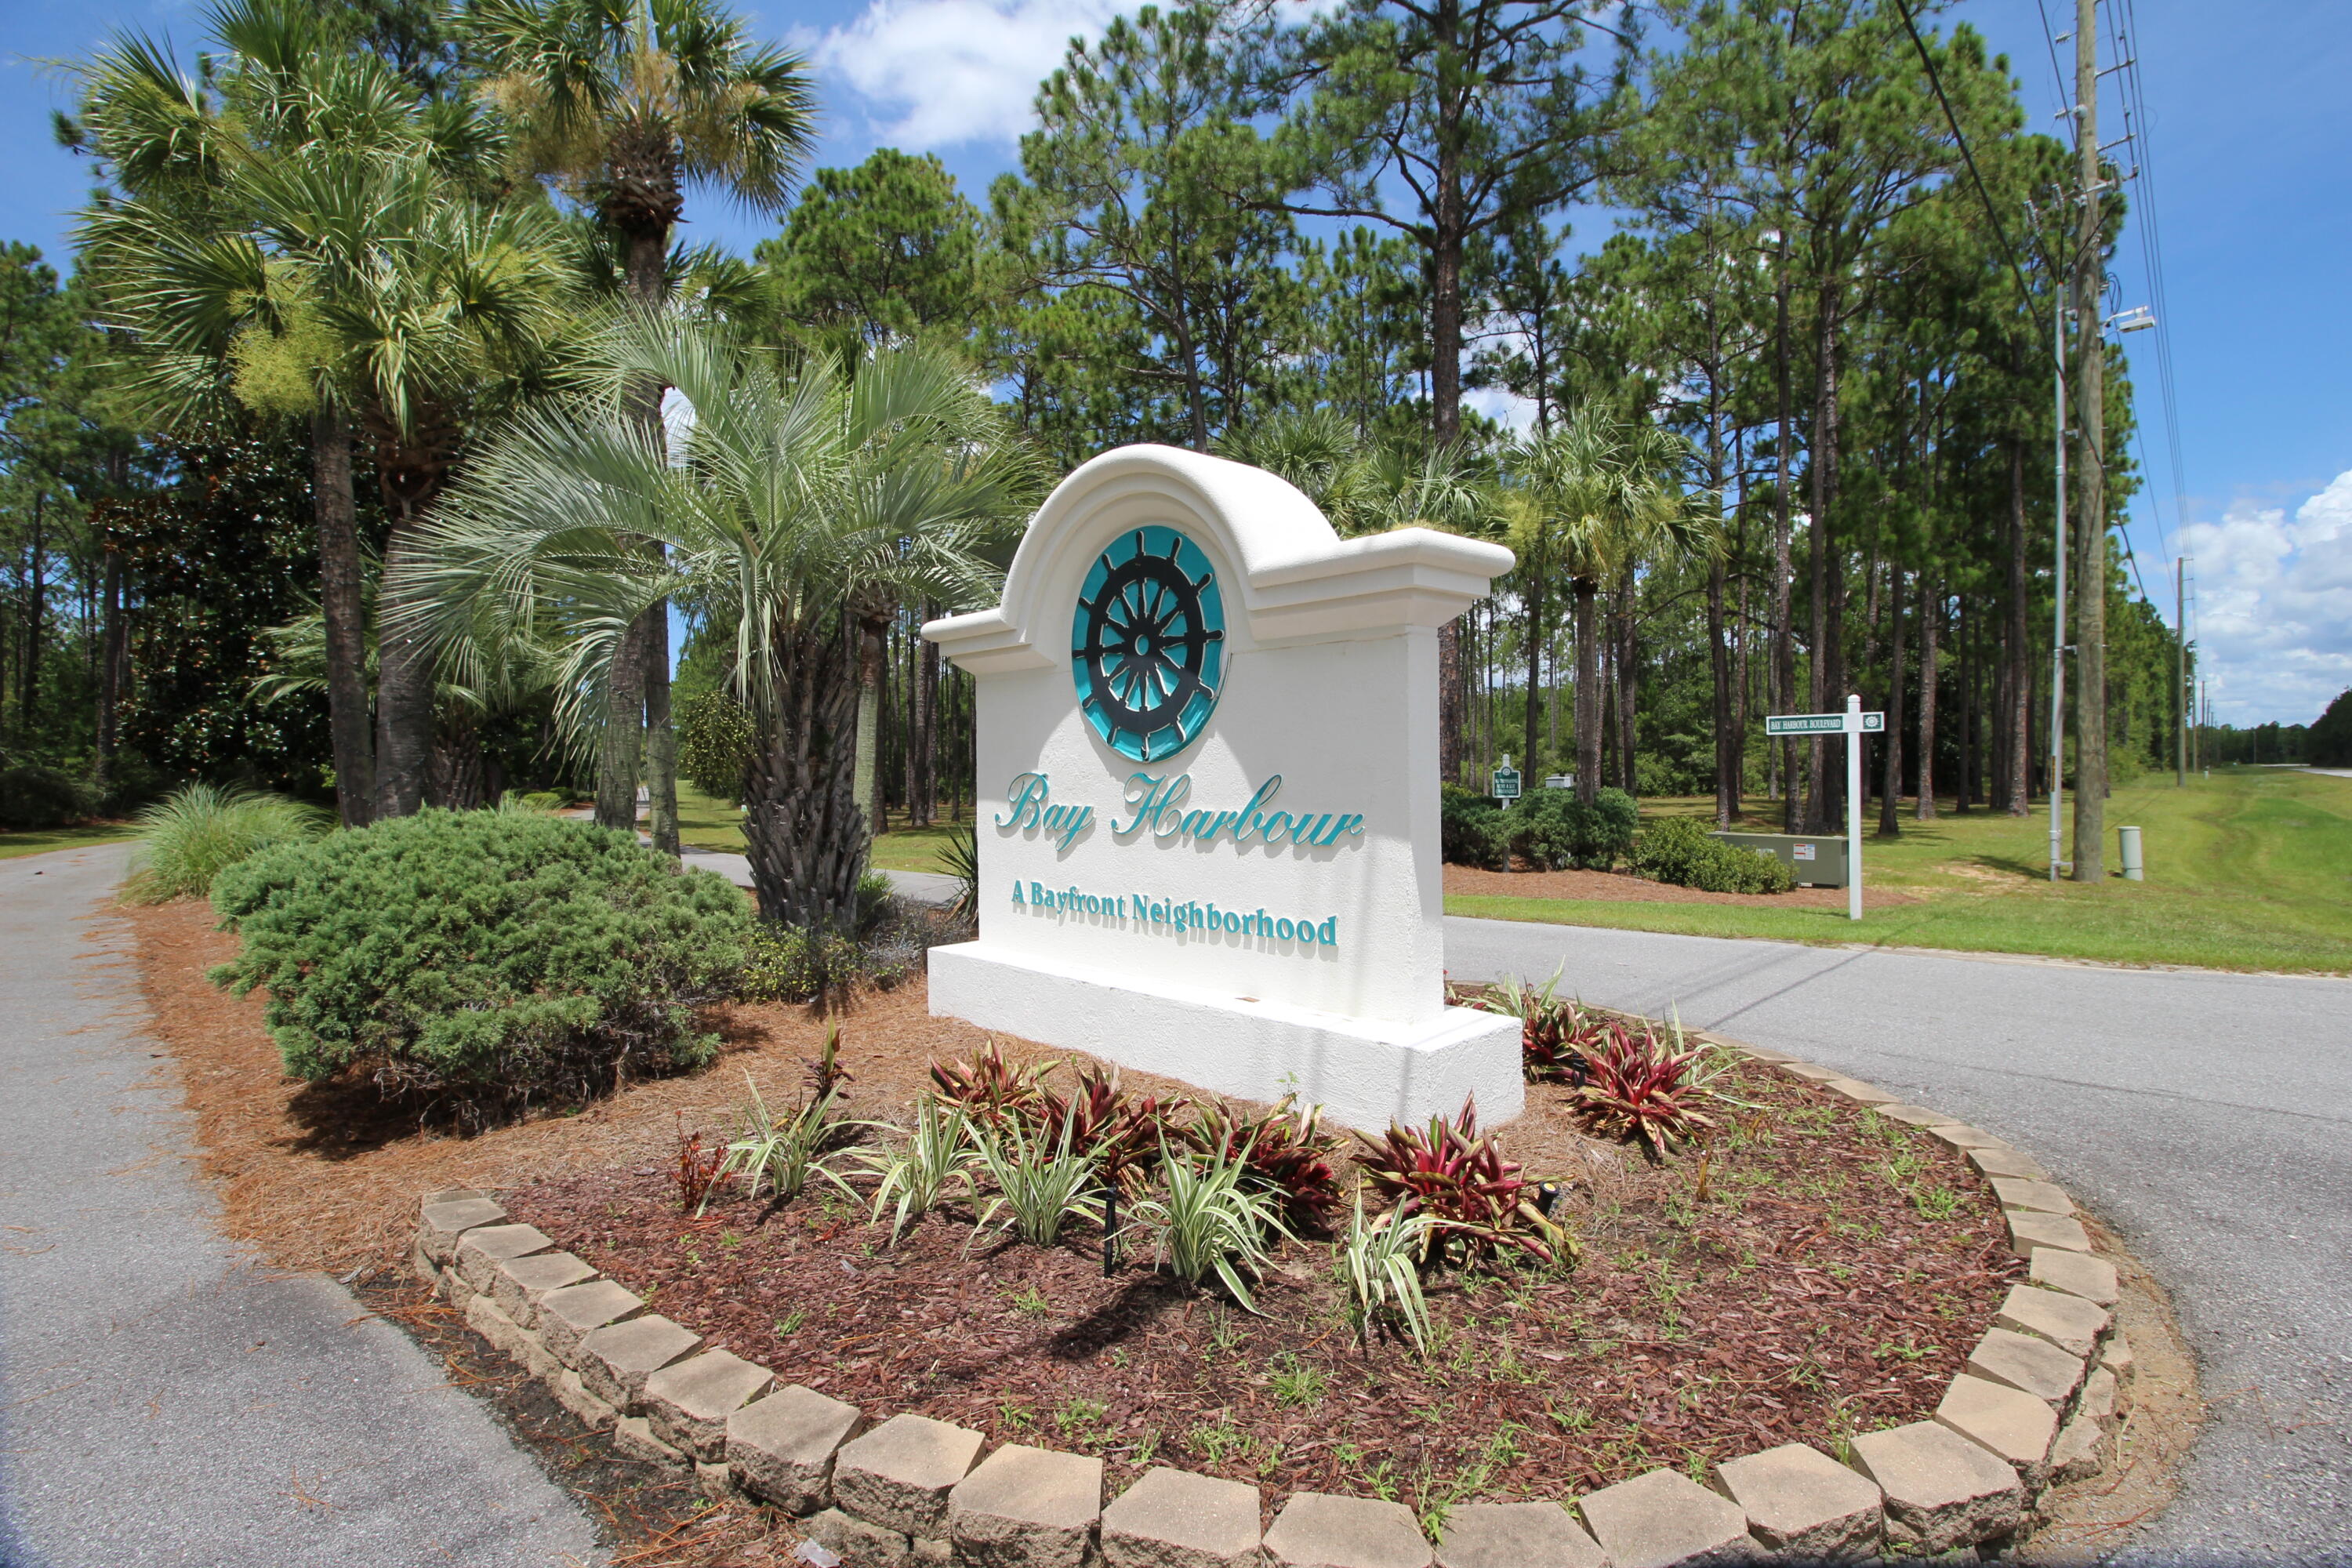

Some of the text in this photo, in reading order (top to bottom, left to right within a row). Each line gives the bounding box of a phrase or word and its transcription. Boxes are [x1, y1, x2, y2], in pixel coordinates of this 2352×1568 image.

[1770, 719, 1841, 730] BAY HARBOUR BOULEVARD
[995, 772, 1365, 851] Bay Harbour
[1011, 880, 1338, 946] A Bayfront Neighborhood
